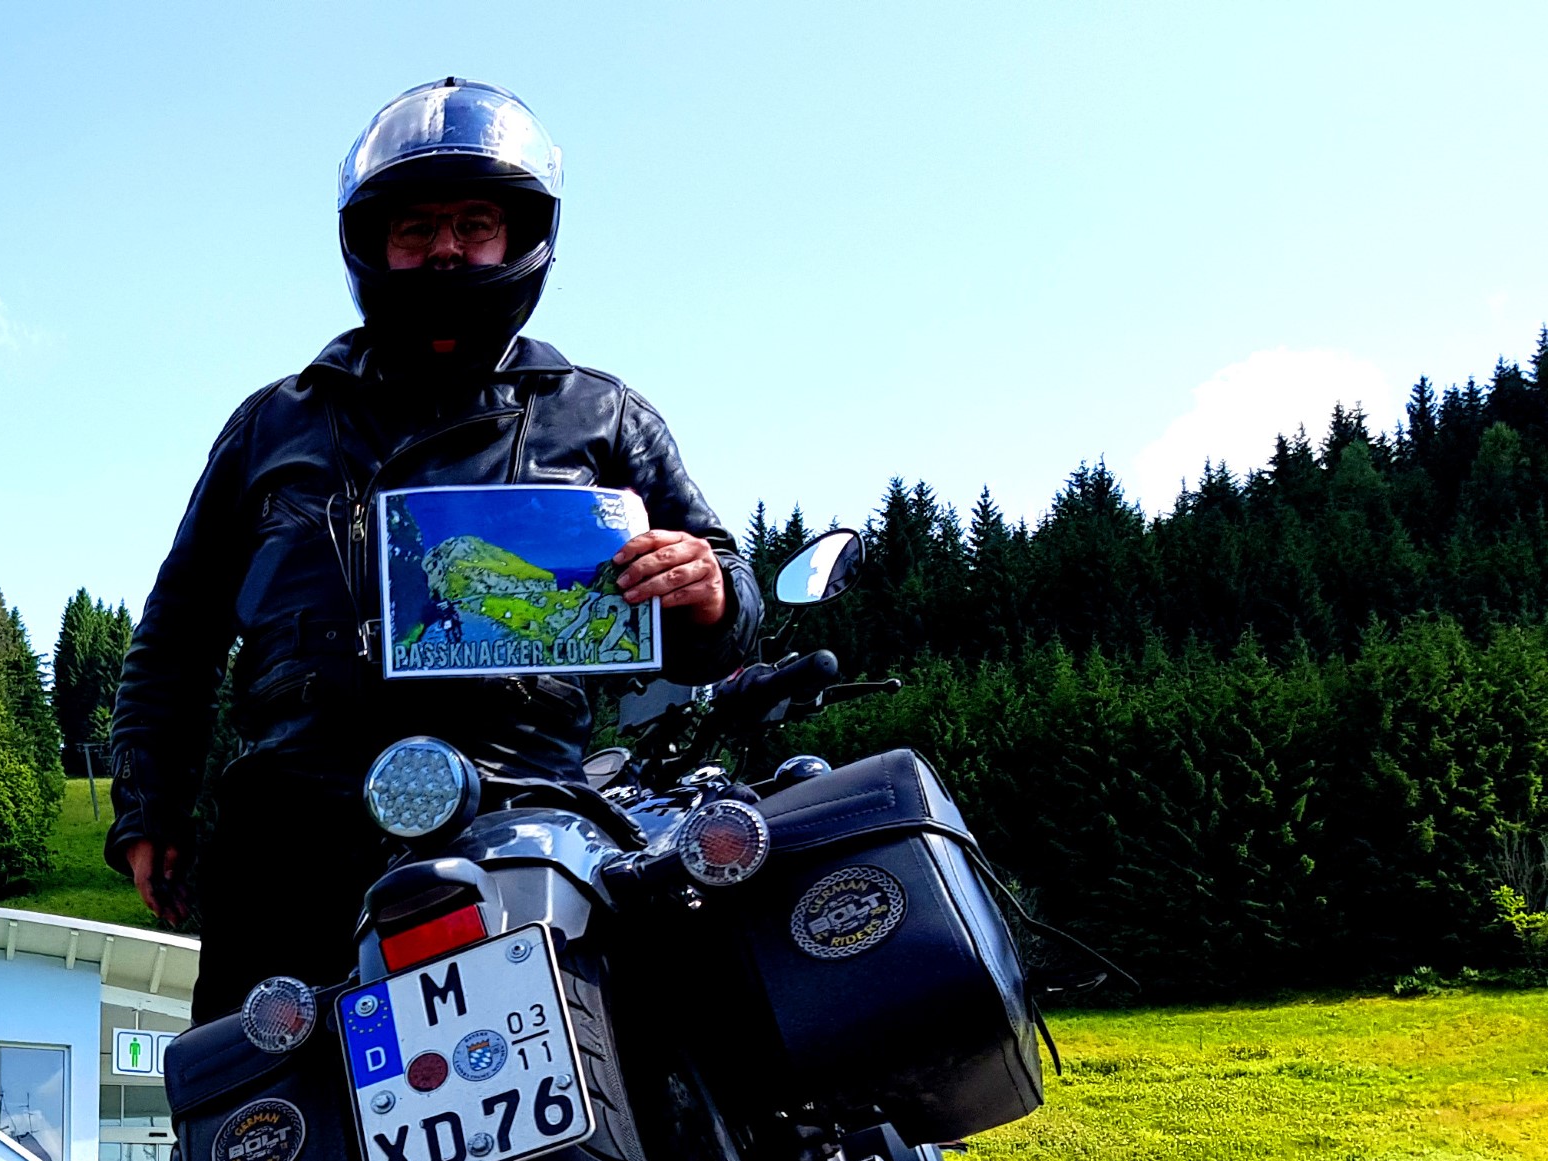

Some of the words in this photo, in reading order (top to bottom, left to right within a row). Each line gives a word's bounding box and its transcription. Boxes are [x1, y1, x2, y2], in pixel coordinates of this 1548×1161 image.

[394, 638, 596, 669] PASSKNACKER.COM
[808, 880, 870, 913] GERMAN
[808, 892, 882, 934] BOLT
[830, 918, 882, 946] RIDERS
[419, 961, 467, 1027] M
[507, 1003, 546, 1035] 03
[365, 1046, 386, 1073] D
[517, 1040, 552, 1070] 11
[235, 1112, 280, 1136] GERMAN
[229, 1126, 291, 1159] BOLT
